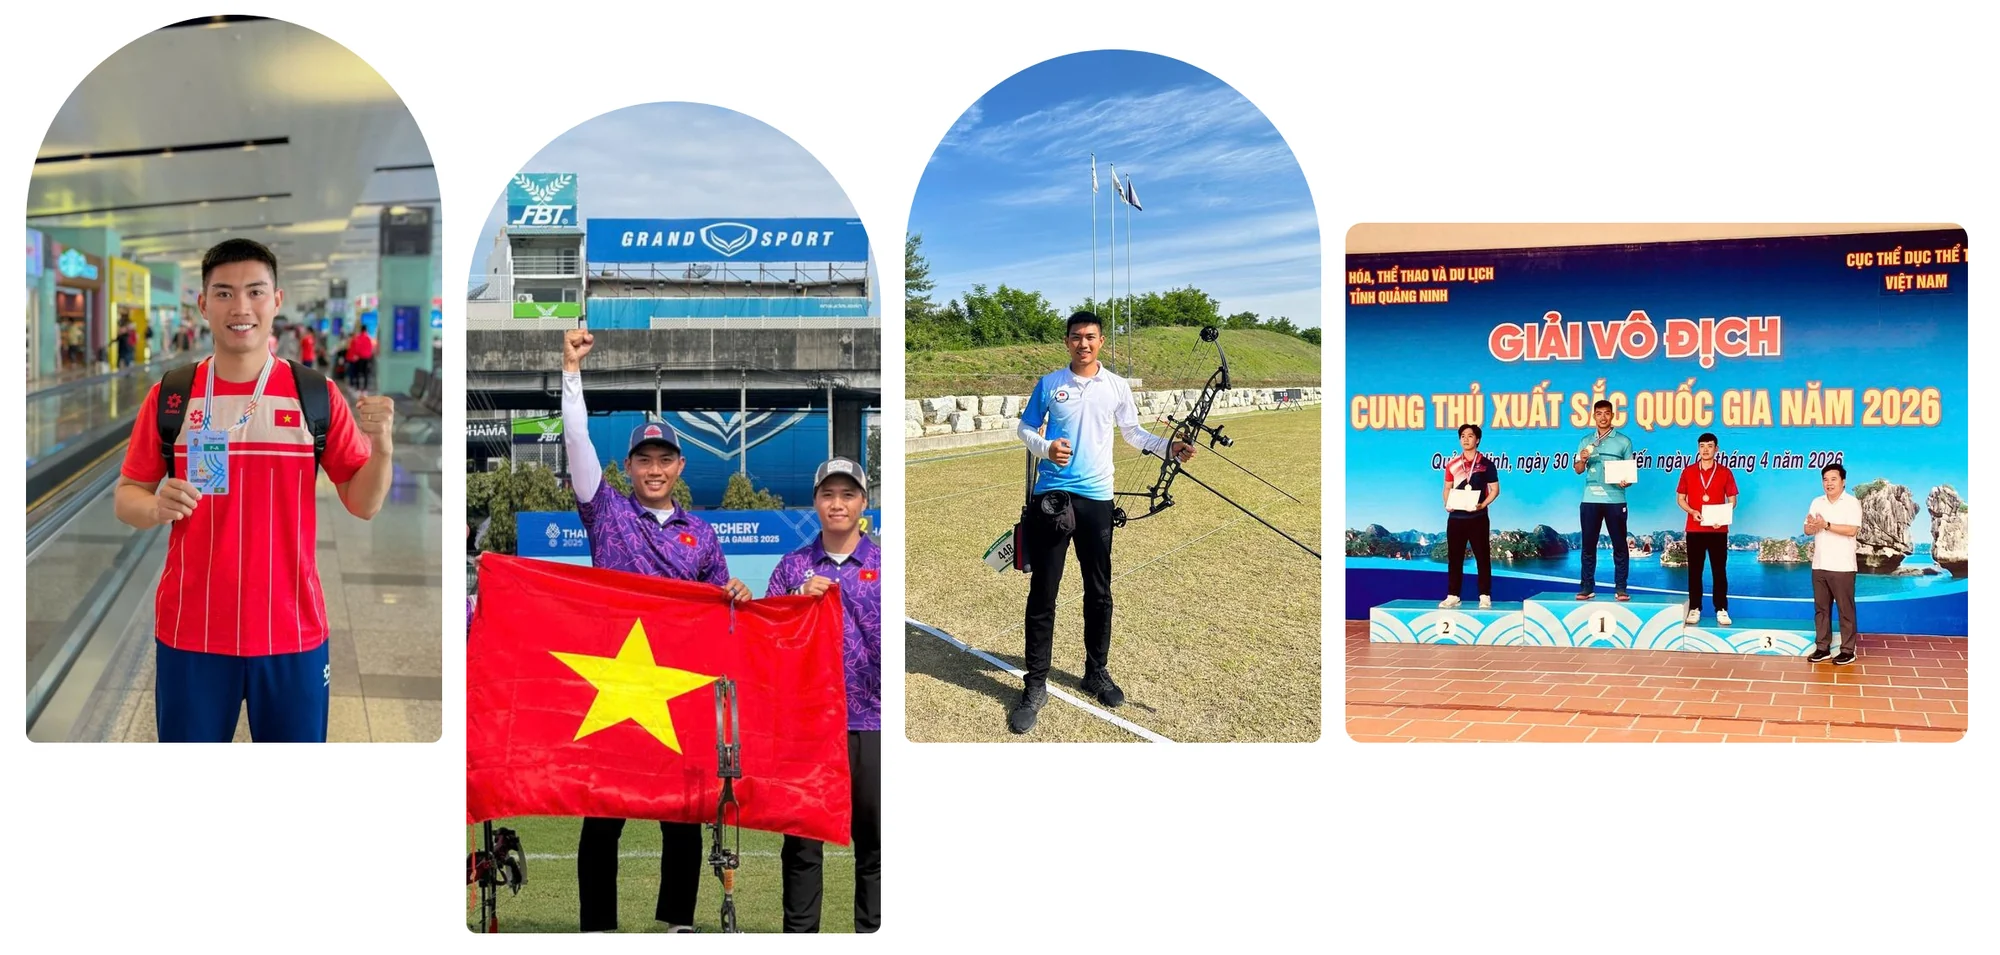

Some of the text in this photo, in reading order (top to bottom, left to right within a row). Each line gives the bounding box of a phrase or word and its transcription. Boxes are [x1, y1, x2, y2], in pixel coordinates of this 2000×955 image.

[512, 205, 573, 224] FBT
[621, 230, 835, 247] GRAND SPORT
[1846, 252, 1873, 270] CỤC
[1877, 245, 1902, 266] THỂ
[1904, 250, 1932, 267] DỤC
[1935, 243, 1961, 263] THỂ
[1348, 265, 1494, 285] HÓA, THỂ THAO VÀ DU LỊCH
[1885, 272, 1948, 292] VIỆT NAM
[1349, 286, 1448, 305] TỈNH QUẢNG NINH
[1488, 310, 1781, 369] GIẢI VÔ ĐỊCH
[1351, 392, 1425, 430] CUNG
[1431, 382, 1484, 429] THỦ
[1491, 380, 1564, 428] XUẤT
[1635, 377, 1713, 431] QUỐC
[1721, 389, 1773, 427] GIA
[1780, 380, 1854, 427] NĂM
[1862, 387, 1942, 427] 2026
[1516, 450, 1550, 474] ngày
[1553, 452, 1569, 470] 30
[1657, 450, 1691, 473] ngày
[1715, 450, 1756, 473] tháng
[1759, 451, 1769, 469] 4
[1772, 452, 1804, 469] năm
[1808, 451, 1844, 469] 2026
[710, 522, 760, 534] RCHERY
[732, 535, 759, 543] GAMES
[760, 535, 780, 543] 2025
[1442, 621, 1450, 634] 2
[1595, 617, 1606, 633] 1
[1764, 636, 1772, 648] 3
